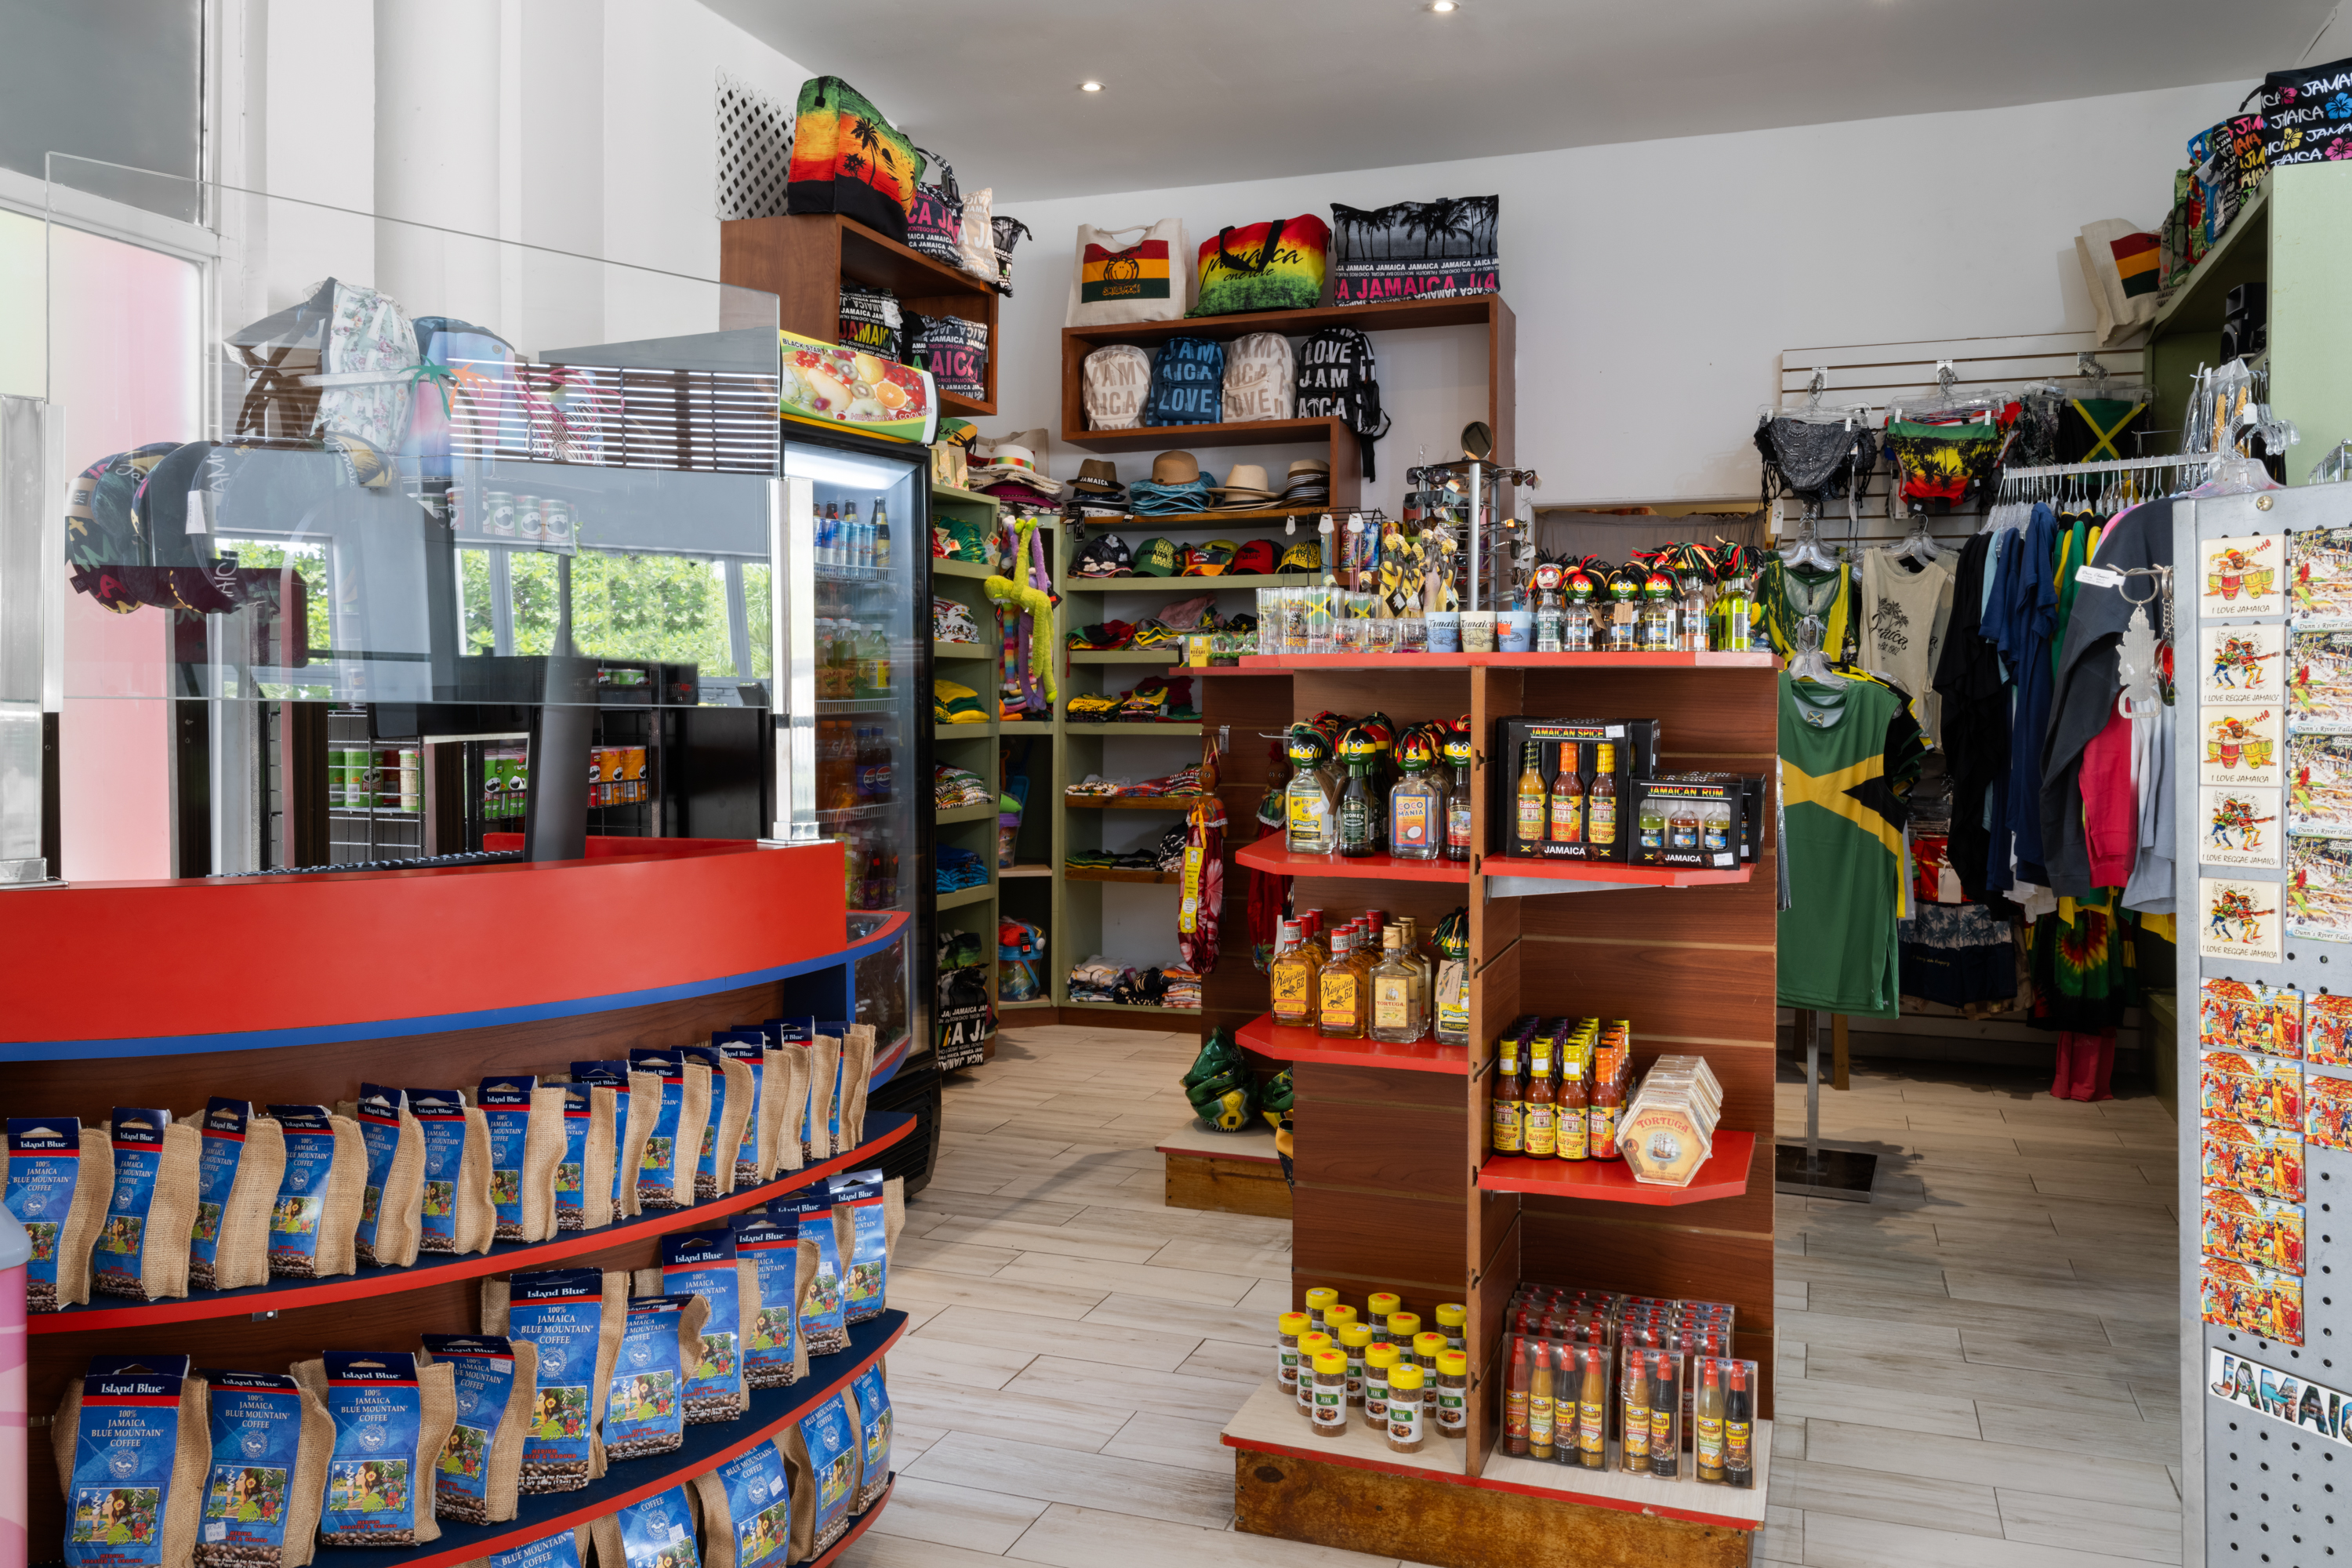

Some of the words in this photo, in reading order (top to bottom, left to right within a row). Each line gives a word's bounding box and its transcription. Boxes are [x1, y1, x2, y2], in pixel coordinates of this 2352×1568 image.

[1408, 262, 1439, 270] JAMAICA
[1441, 260, 1472, 269] JAMAICA
[1356, 275, 1455, 299] JAMAICA
[839, 320, 894, 351] JAMAICA
[929, 336, 965, 345] JAMAICA
[782, 337, 804, 350] BLACK
[805, 343, 822, 354] STAR
[1163, 340, 1215, 364] JAM
[1305, 339, 1353, 366] LOVE
[1162, 363, 1213, 381] AICA
[1298, 368, 1349, 389] JAM
[1158, 388, 1214, 413] LOVE
[1223, 388, 1272, 419] LOVE
[850, 412, 890, 422] HEALTHY
[898, 407, 933, 420] COOLING
[1080, 476, 1109, 486] JAMAICA
[2216, 606, 2236, 615] LOVE
[2237, 604, 2270, 614] JAMAICA
[2225, 694, 2251, 702] REGGAE
[2252, 694, 2281, 702] JAMAICA
[1530, 728, 1575, 737] JAMAICAN
[1577, 729, 1604, 739] SPICE
[1648, 786, 1697, 797] JAMAICAN
[1702, 788, 1724, 798] RUM
[1398, 800, 1423, 811] COCO
[1552, 802, 1573, 811] Eaton's
[1398, 809, 1424, 818] MANIA
[1544, 845, 1587, 855] JAMAICA
[1664, 854, 1701, 862] JAMAICA
[2223, 855, 2249, 864] REGGAE
[2293, 928, 2316, 937] Dunn's
[2318, 931, 2335, 939] River
[2223, 947, 2249, 956] REGGAE
[2249, 949, 2278, 959] JAMAICA
[1274, 969, 1306, 990] Kingston
[1296, 977, 1305, 989] 62
[1321, 978, 1355, 1000] Kingston
[1344, 986, 1353, 1000] 62
[2270, 1047, 2296, 1056] Jamaica
[487, 1095, 506, 1105] Island
[1495, 1105, 1514, 1114] Eaton's
[1636, 1116, 1689, 1133] TORTUGA
[2270, 1120, 2296, 1129] Jamaica
[120, 1131, 138, 1142] Island
[20, 1140, 45, 1149] Island
[838, 1192, 858, 1202] Island
[2271, 1189, 2297, 1200] Jamaica
[739, 1234, 764, 1243] Island
[675, 1254, 702, 1264] Island
[702, 1252, 721, 1261] Blue
[2271, 1263, 2297, 1274] Jamaica
[685, 1279, 715, 1289] JAMAICA
[527, 1288, 559, 1298] Island
[547, 1305, 567, 1314] 100%
[537, 1315, 575, 1323] JAMAICA
[521, 1325, 542, 1334] BLUE
[539, 1335, 571, 1345] COFFEE
[2270, 1331, 2296, 1343] Jamaica
[459, 1363, 490, 1373] JAMAICA
[342, 1371, 374, 1380] Island
[101, 1384, 134, 1396] Island
[136, 1384, 162, 1394] Blue
[460, 1378, 485, 1391] COFFEE
[239, 1401, 274, 1410] JAMAICA
[225, 1409, 244, 1418] BLUE
[107, 1419, 146, 1428] JAMAICA
[241, 1420, 270, 1429] COFFEE
[91, 1429, 112, 1438] BLUE
[110, 1439, 141, 1448] COFFEE
[726, 1465, 742, 1477] BLUE
[742, 1462, 764, 1479] COFFEE
[641, 1496, 665, 1512] COFFEE
[501, 1552, 523, 1566] BLUE
[522, 1551, 553, 1568] COFFEE
